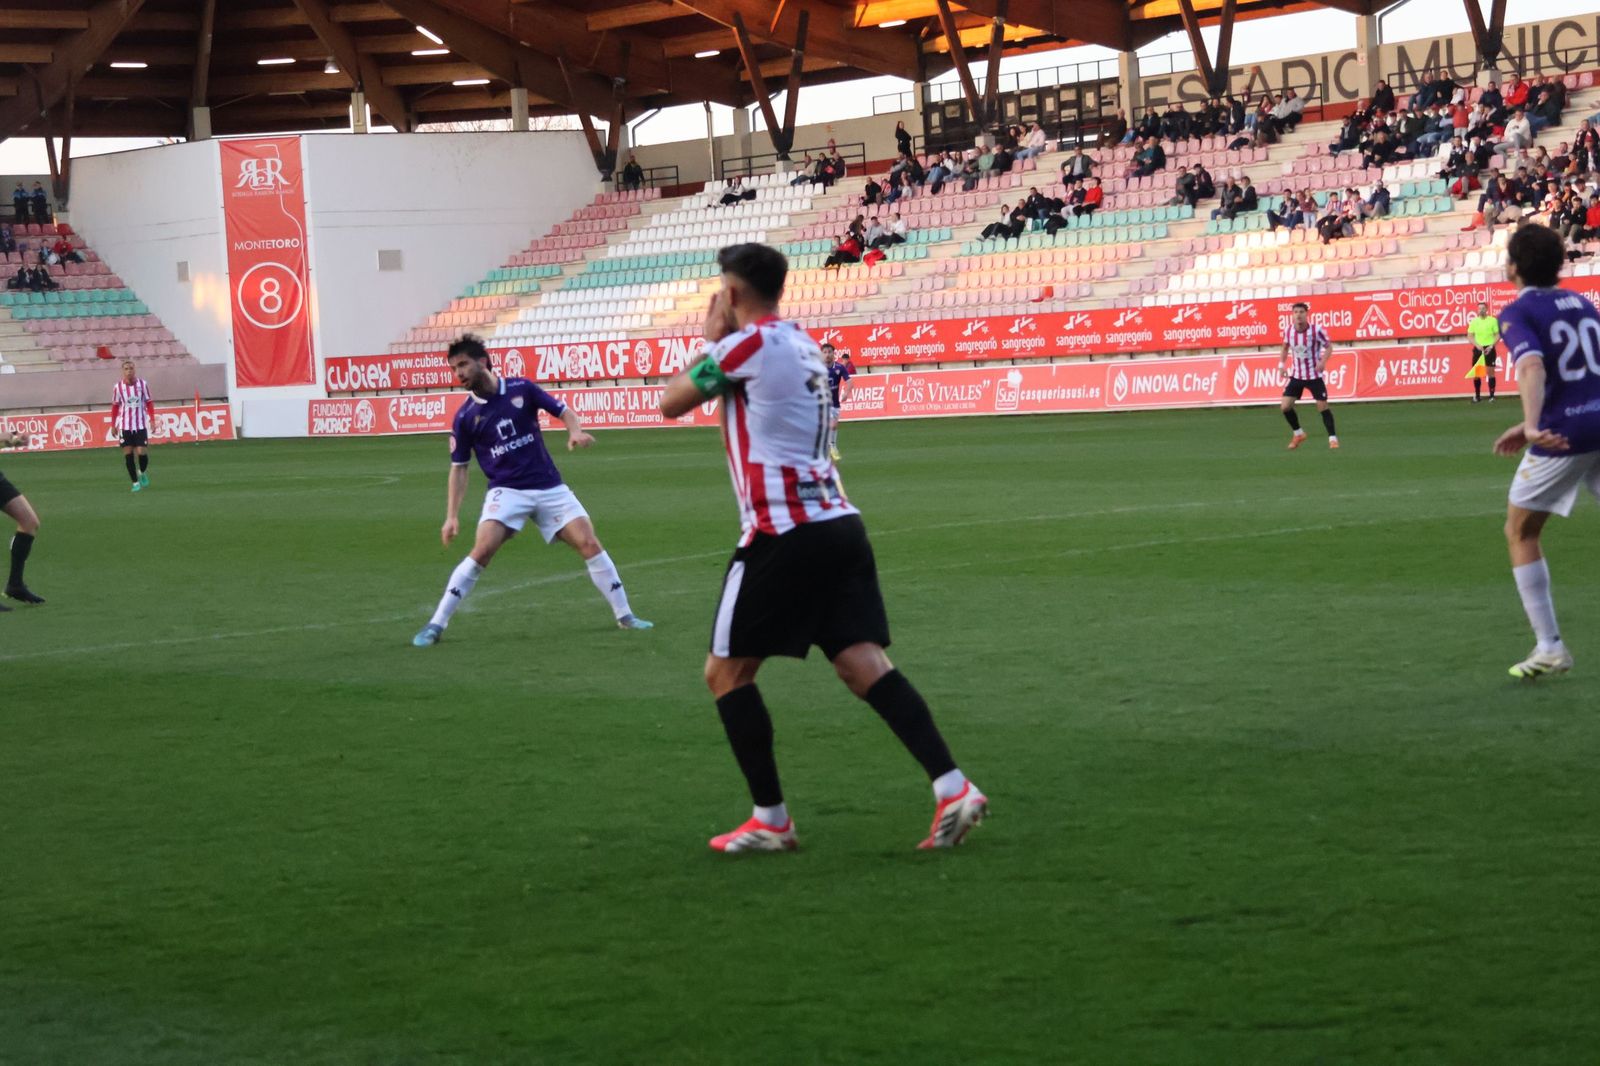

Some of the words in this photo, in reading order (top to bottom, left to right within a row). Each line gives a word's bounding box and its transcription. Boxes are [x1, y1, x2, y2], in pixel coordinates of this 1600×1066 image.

[235, 238, 300, 251] MONTETORO
[259, 277, 283, 314] 8
[1445, 287, 1489, 304] Dental
[1105, 329, 1153, 347] sangregorio
[1163, 326, 1212, 343] sangregorio
[1216, 321, 1268, 340] sangregorio
[955, 338, 997, 354] sangregorio
[1001, 335, 1046, 351] sangregorio
[1056, 332, 1101, 348] sangregorio
[860, 343, 900, 360] sangregorio
[904, 341, 945, 357] sangregorio
[1550, 318, 1600, 381] 20
[535, 344, 605, 380] ZAMORA
[606, 341, 631, 377] CF
[1389, 357, 1450, 376] VERSUS
[412, 373, 425, 385] 675
[426, 372, 438, 384] 630
[440, 371, 452, 383] 110
[1132, 374, 1180, 395] INNOVA
[1182, 372, 1218, 396] Chef
[1395, 375, 1443, 386] E-LEARNING
[400, 396, 446, 419] Freigel
[573, 392, 613, 412] CAMINO
[614, 391, 626, 410] DE
[627, 391, 644, 409] LA
[199, 410, 227, 435] CF
[594, 412, 606, 424] del
[608, 412, 625, 423] Vino
[626, 411, 664, 424] (Zamora)
[492, 489, 504, 501] 2
